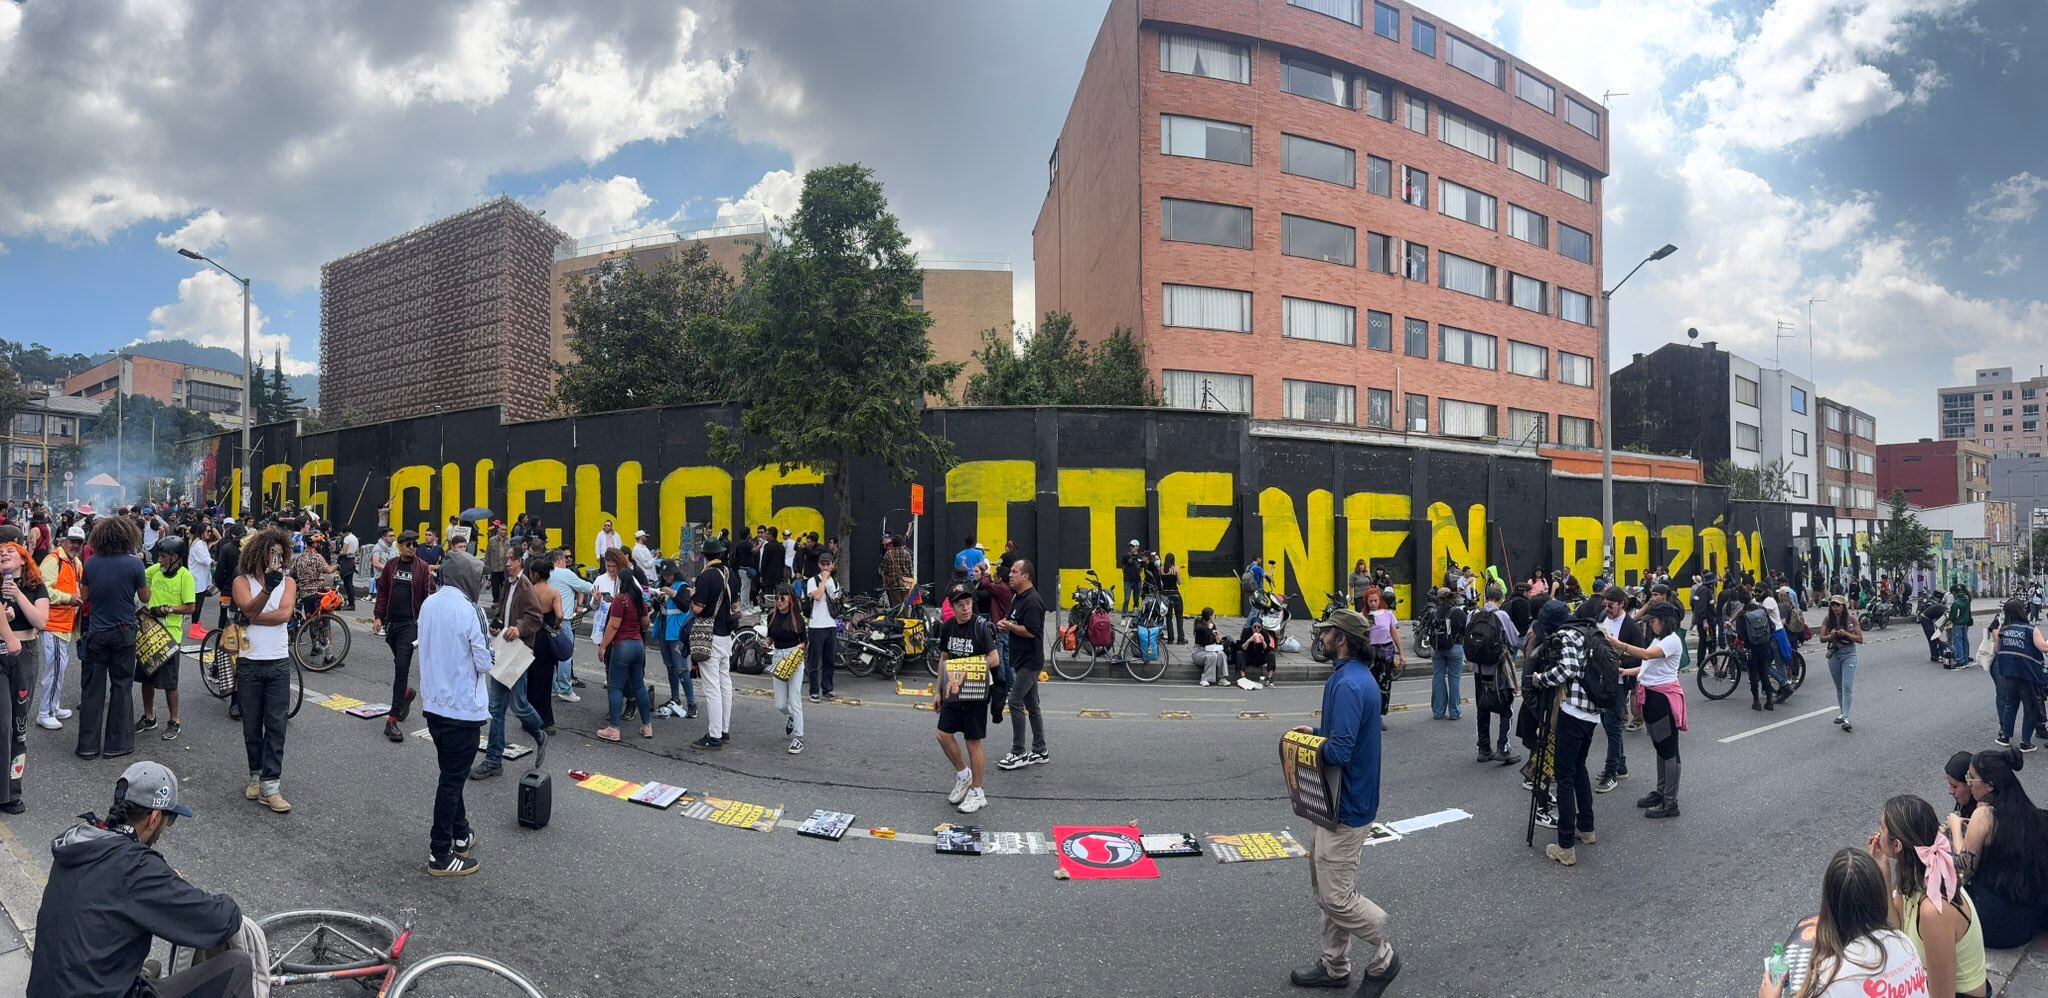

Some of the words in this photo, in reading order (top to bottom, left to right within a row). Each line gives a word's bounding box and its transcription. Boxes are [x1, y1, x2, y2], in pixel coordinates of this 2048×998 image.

[388, 457, 826, 570] CUCHAS
[946, 458, 1487, 620] TIENEN
[945, 664, 987, 673] CUCHAS
[966, 672, 987, 681] LAS
[1298, 746, 1318, 768] LAS
[152, 797, 171, 808] 1937
